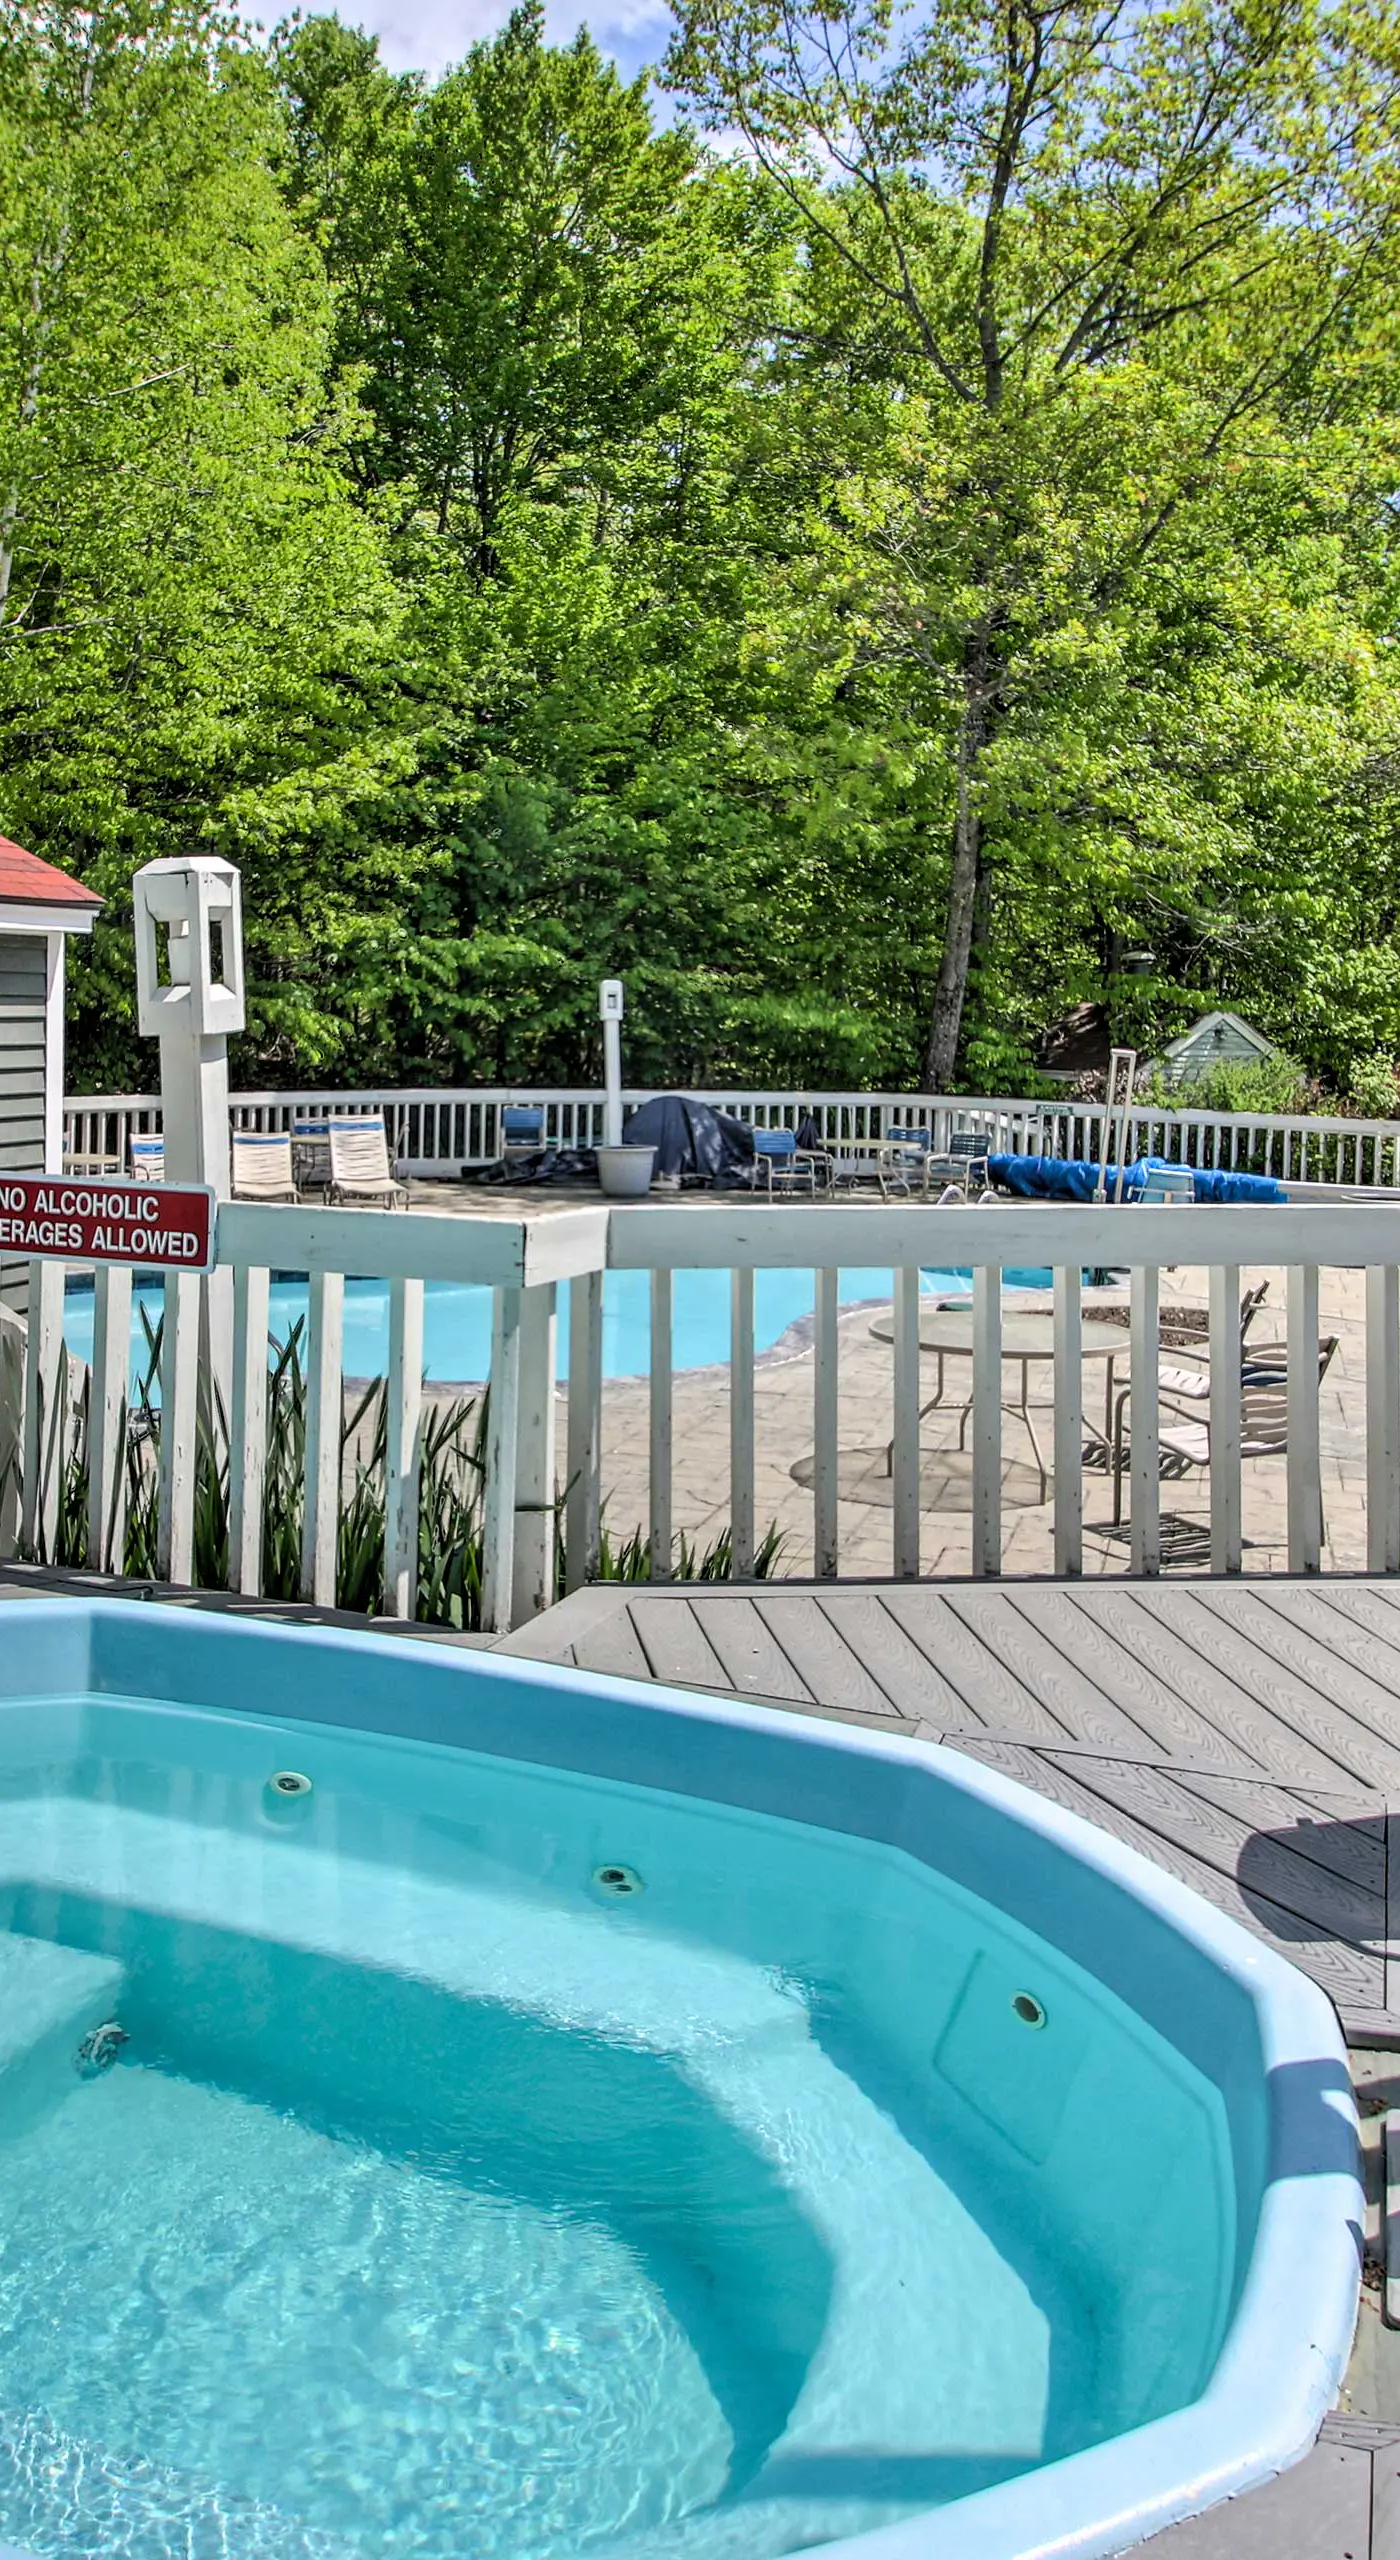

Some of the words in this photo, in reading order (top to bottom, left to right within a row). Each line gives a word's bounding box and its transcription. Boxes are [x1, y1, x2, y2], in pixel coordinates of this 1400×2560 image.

[0, 1186, 26, 1212] NO
[34, 1189, 159, 1222] ALCOHOLIC
[91, 1226, 199, 1258] ALLOWED
